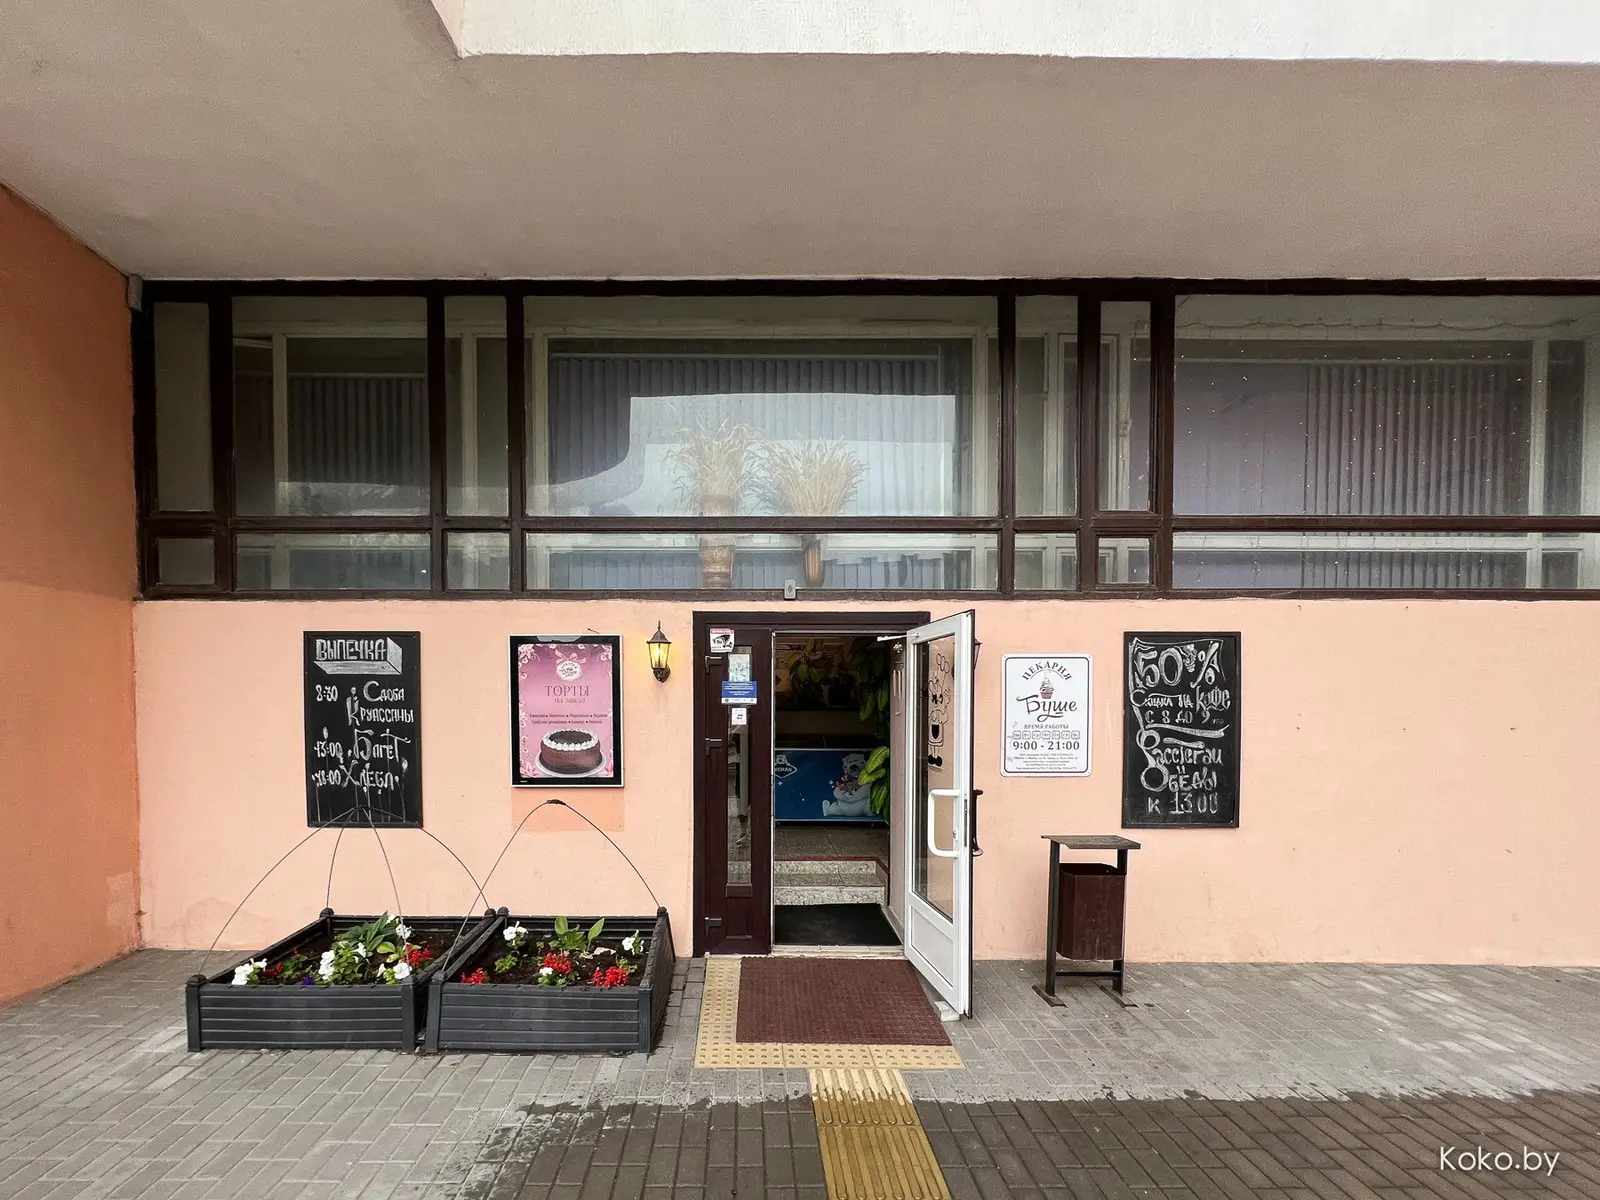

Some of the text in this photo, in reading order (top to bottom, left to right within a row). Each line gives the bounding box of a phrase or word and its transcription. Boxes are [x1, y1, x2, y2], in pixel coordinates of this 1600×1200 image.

[315, 638, 387, 661] ВЫПЕЧКА
[1022, 661, 1072, 681] ПЕКАРНЯ
[315, 684, 339, 702] 8:30
[545, 685, 589, 697] ТОРТЫ
[1016, 694, 1078, 722] Буше
[1161, 710, 1171, 723] 8
[1202, 710, 1211, 724] 9
[314, 740, 343, 758] 13:00
[1012, 740, 1038, 750] 9:00
[1047, 740, 1080, 750] 21:00
